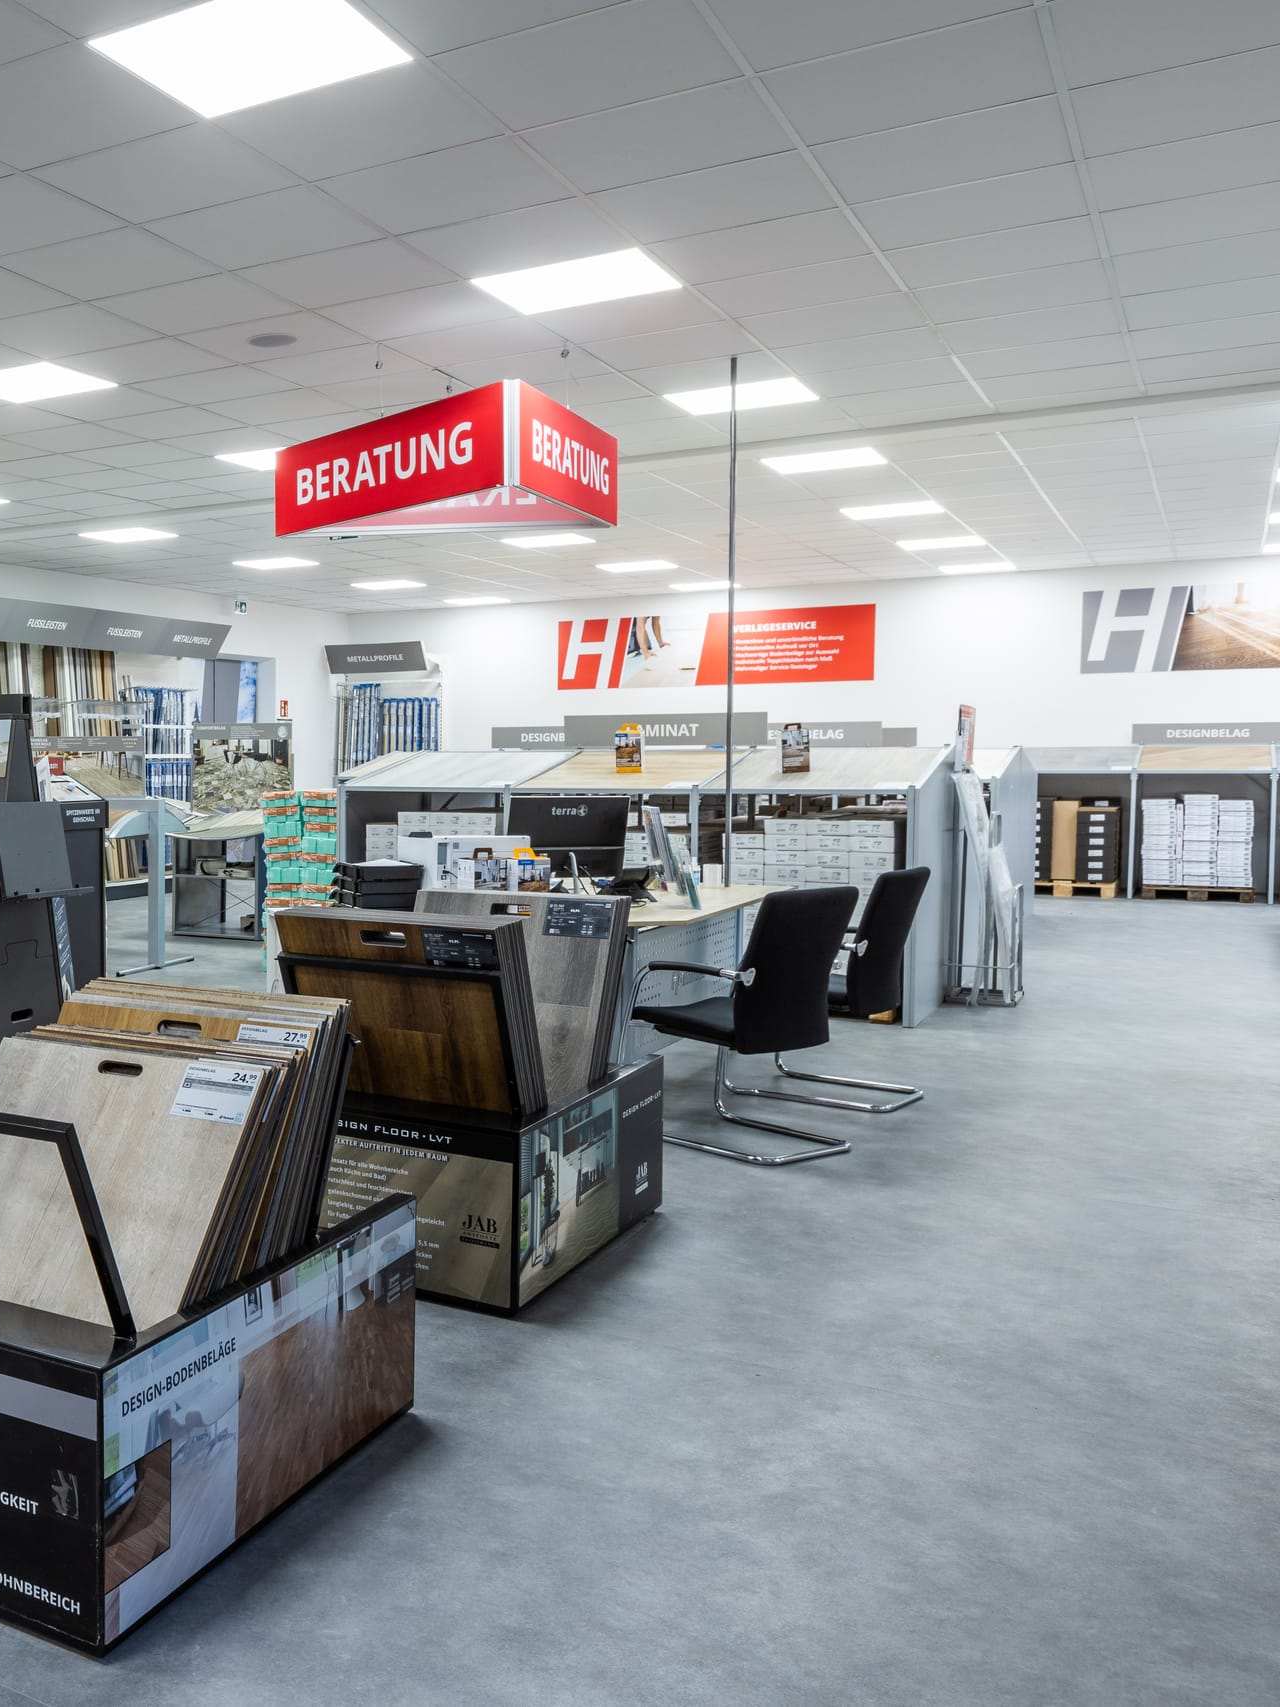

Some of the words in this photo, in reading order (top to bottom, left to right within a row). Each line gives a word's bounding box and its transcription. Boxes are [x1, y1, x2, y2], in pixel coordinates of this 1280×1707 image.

[532, 418, 610, 495] BERATUNG
[296, 422, 473, 506] BERATUNG
[27, 618, 68, 631] FUSSLEISTEN
[733, 621, 817, 633] VERLEGESERVICE
[107, 627, 143, 639] FUSSLEISTEN
[173, 634, 212, 645] METALLPROFILE
[346, 654, 404, 663] METALLPROFILE
[521, 732, 565, 743] DESIGNB
[1166, 728, 1250, 738] DESIGNBELAG
[552, 806, 576, 816] terra
[622, 1104, 639, 1119] DESIGN
[338, 1120, 368, 1131] SIGN
[360, 1140, 392, 1153] AUFTRITT
[403, 1149, 425, 1158] JEDEM
[426, 1152, 448, 1162] RAUM
[344, 1168, 361, 1176] Küche
[373, 1172, 387, 1181] Bad)
[368, 1163, 408, 1176] Wohnbereiche
[328, 1177, 355, 1186] rutschfest
[356, 1181, 367, 1189] und
[328, 1188, 372, 1201] gelenkschonend
[462, 1214, 497, 1233] JAB
[122, 1337, 236, 1418] DESIGN-BODENBELÄGE
